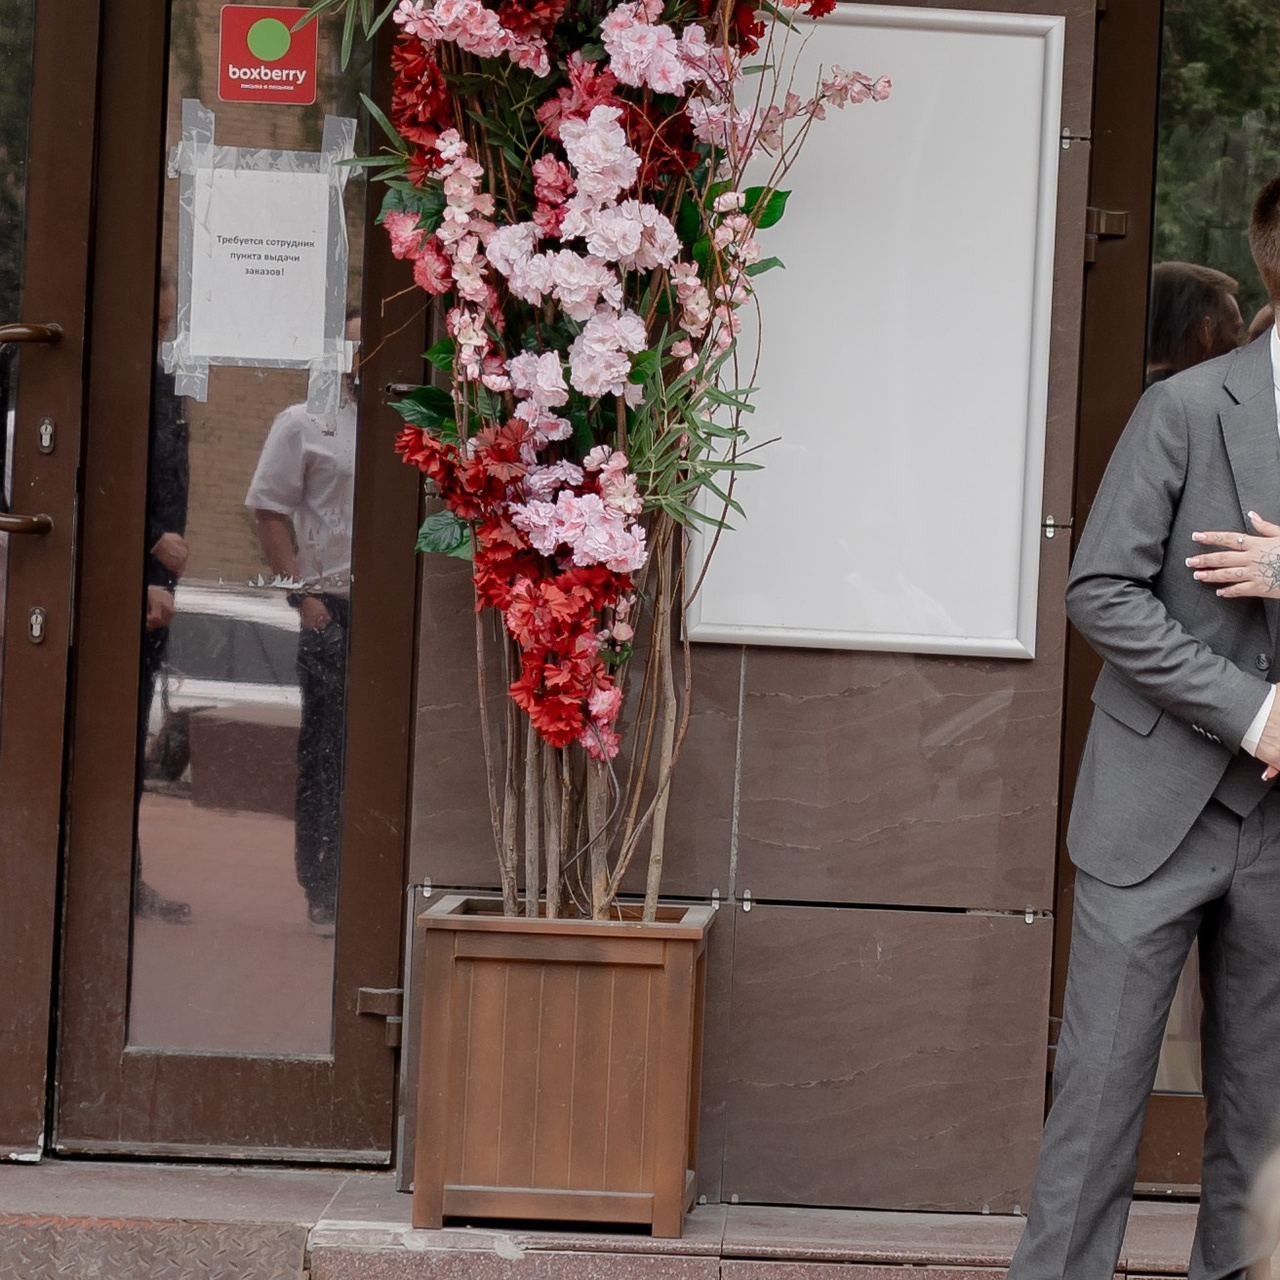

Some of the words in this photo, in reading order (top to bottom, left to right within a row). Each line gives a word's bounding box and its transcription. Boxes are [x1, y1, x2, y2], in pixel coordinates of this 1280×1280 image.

[228, 64, 307, 85] boxberry
[216, 235, 264, 246] Требуется
[265, 239, 315, 249] сотрудник
[230, 252, 262, 261] пункта
[264, 254, 300, 262] выдачи
[244, 267, 285, 276] заказов!
